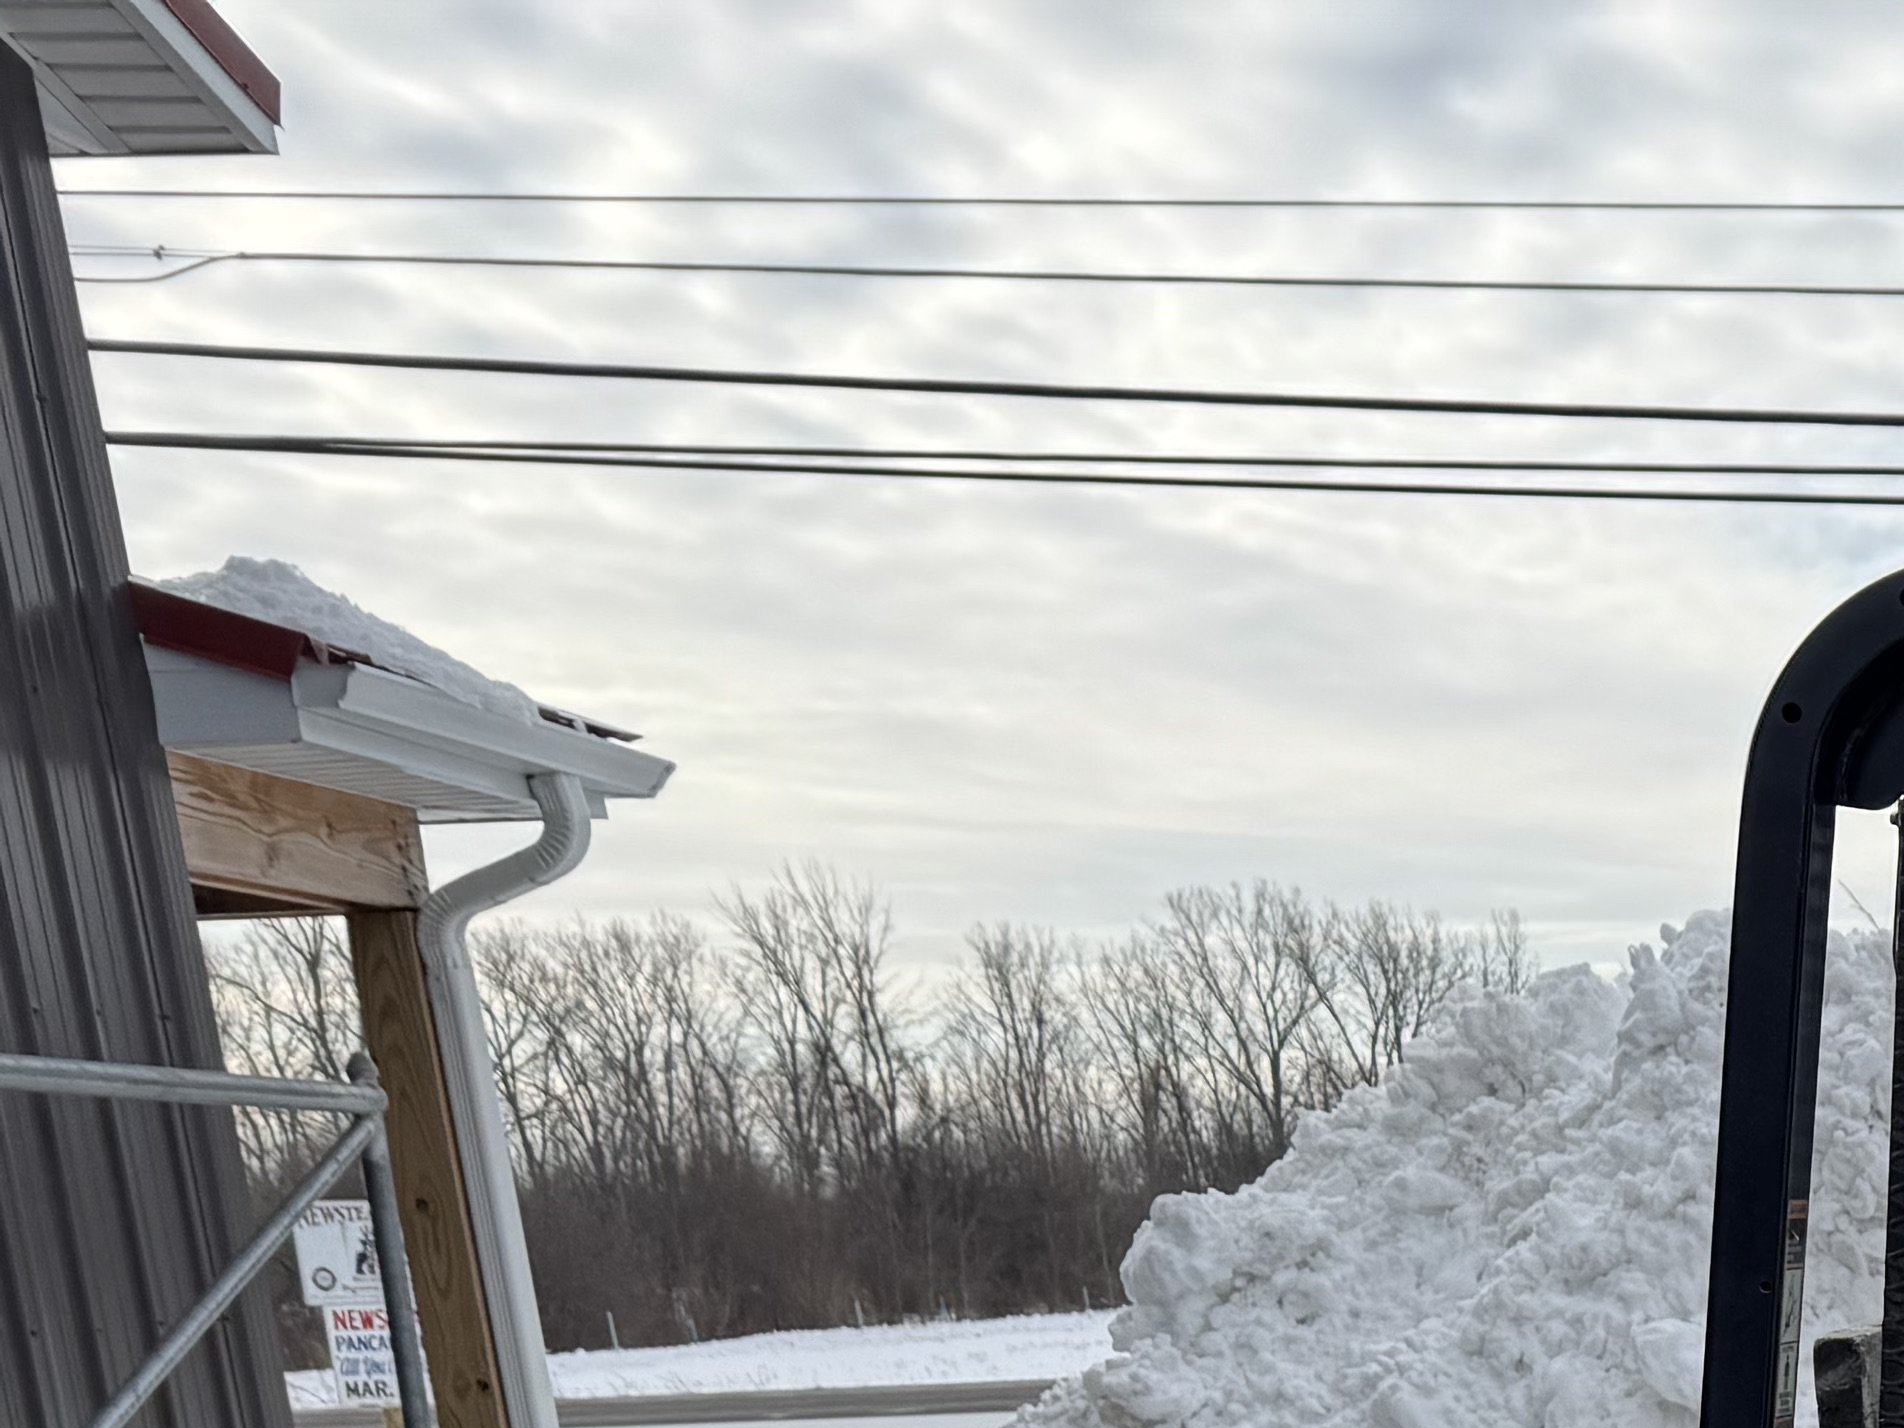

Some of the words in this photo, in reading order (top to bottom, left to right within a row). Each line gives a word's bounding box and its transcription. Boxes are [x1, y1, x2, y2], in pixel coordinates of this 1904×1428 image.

[332, 1309, 388, 1331] NEWS
[335, 1334, 389, 1352] PANCA
[345, 1380, 394, 1399] MAR.
